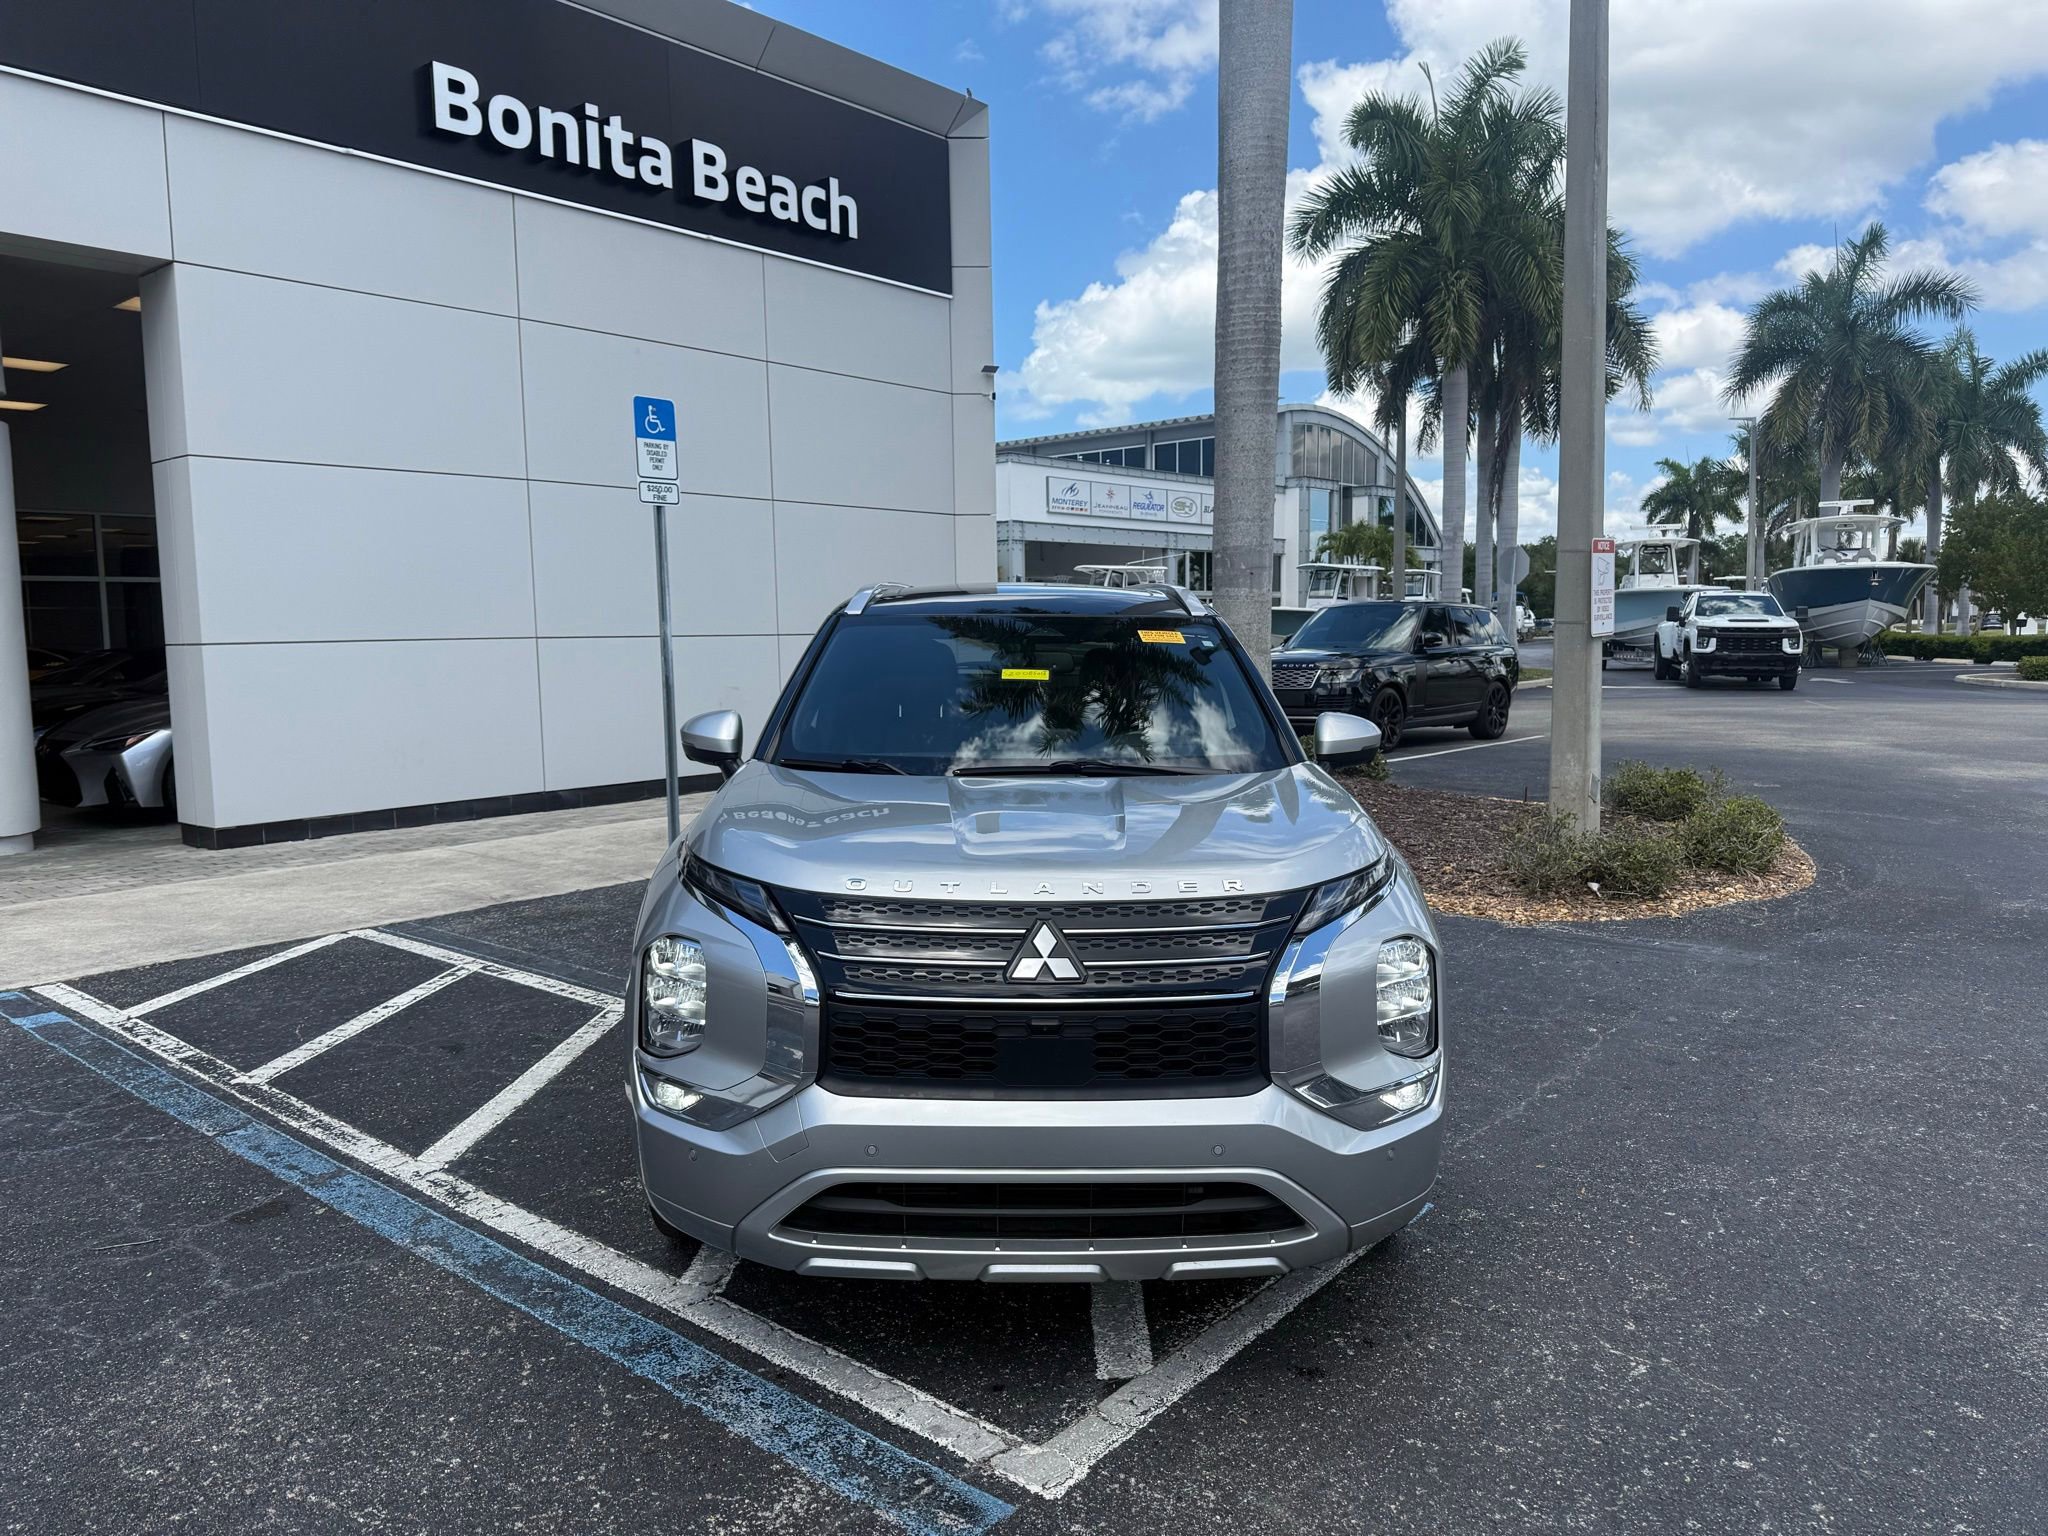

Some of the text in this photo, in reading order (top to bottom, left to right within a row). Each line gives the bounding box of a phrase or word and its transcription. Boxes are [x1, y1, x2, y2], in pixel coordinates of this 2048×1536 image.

[432, 60, 858, 240] Bonita Beach
[643, 442, 662, 450] PARKING
[646, 449, 668, 457] DISABLED
[646, 484, 673, 494] $250.00
[652, 494, 668, 502] FINE
[1051, 497, 1088, 507] MONTEREY
[1093, 502, 1128, 511] JEANNEAU
[1132, 501, 1165, 512] REGULATOR
[845, 878, 1246, 895] OUTLANDER
